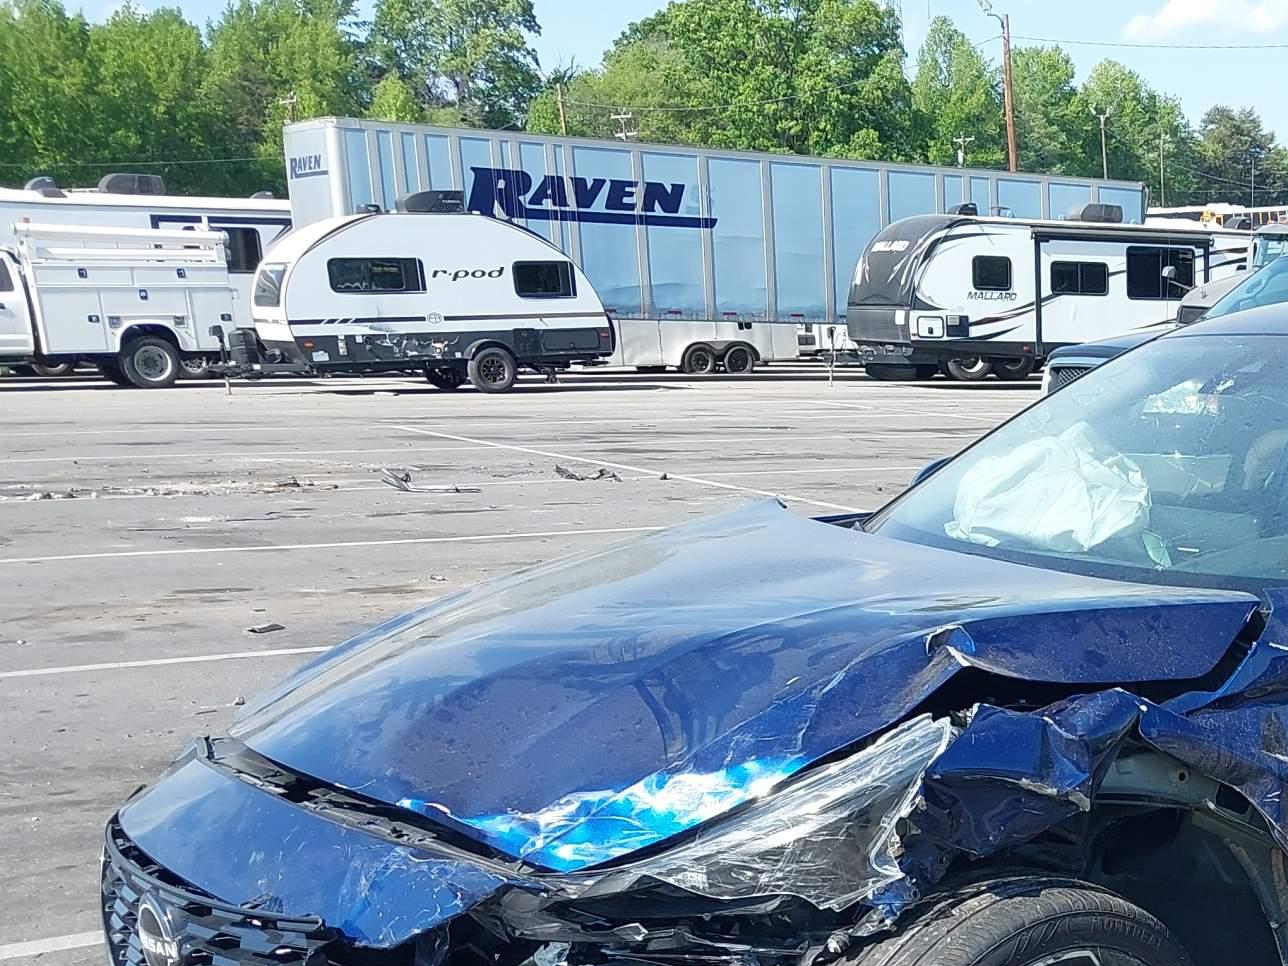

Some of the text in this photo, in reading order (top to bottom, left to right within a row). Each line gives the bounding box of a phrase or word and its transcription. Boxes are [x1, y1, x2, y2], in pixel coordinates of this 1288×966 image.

[289, 154, 321, 179] RAVEN
[467, 167, 685, 220] RAVEN
[967, 291, 1017, 301] MALLARD
[139, 928, 178, 959] SSAN
